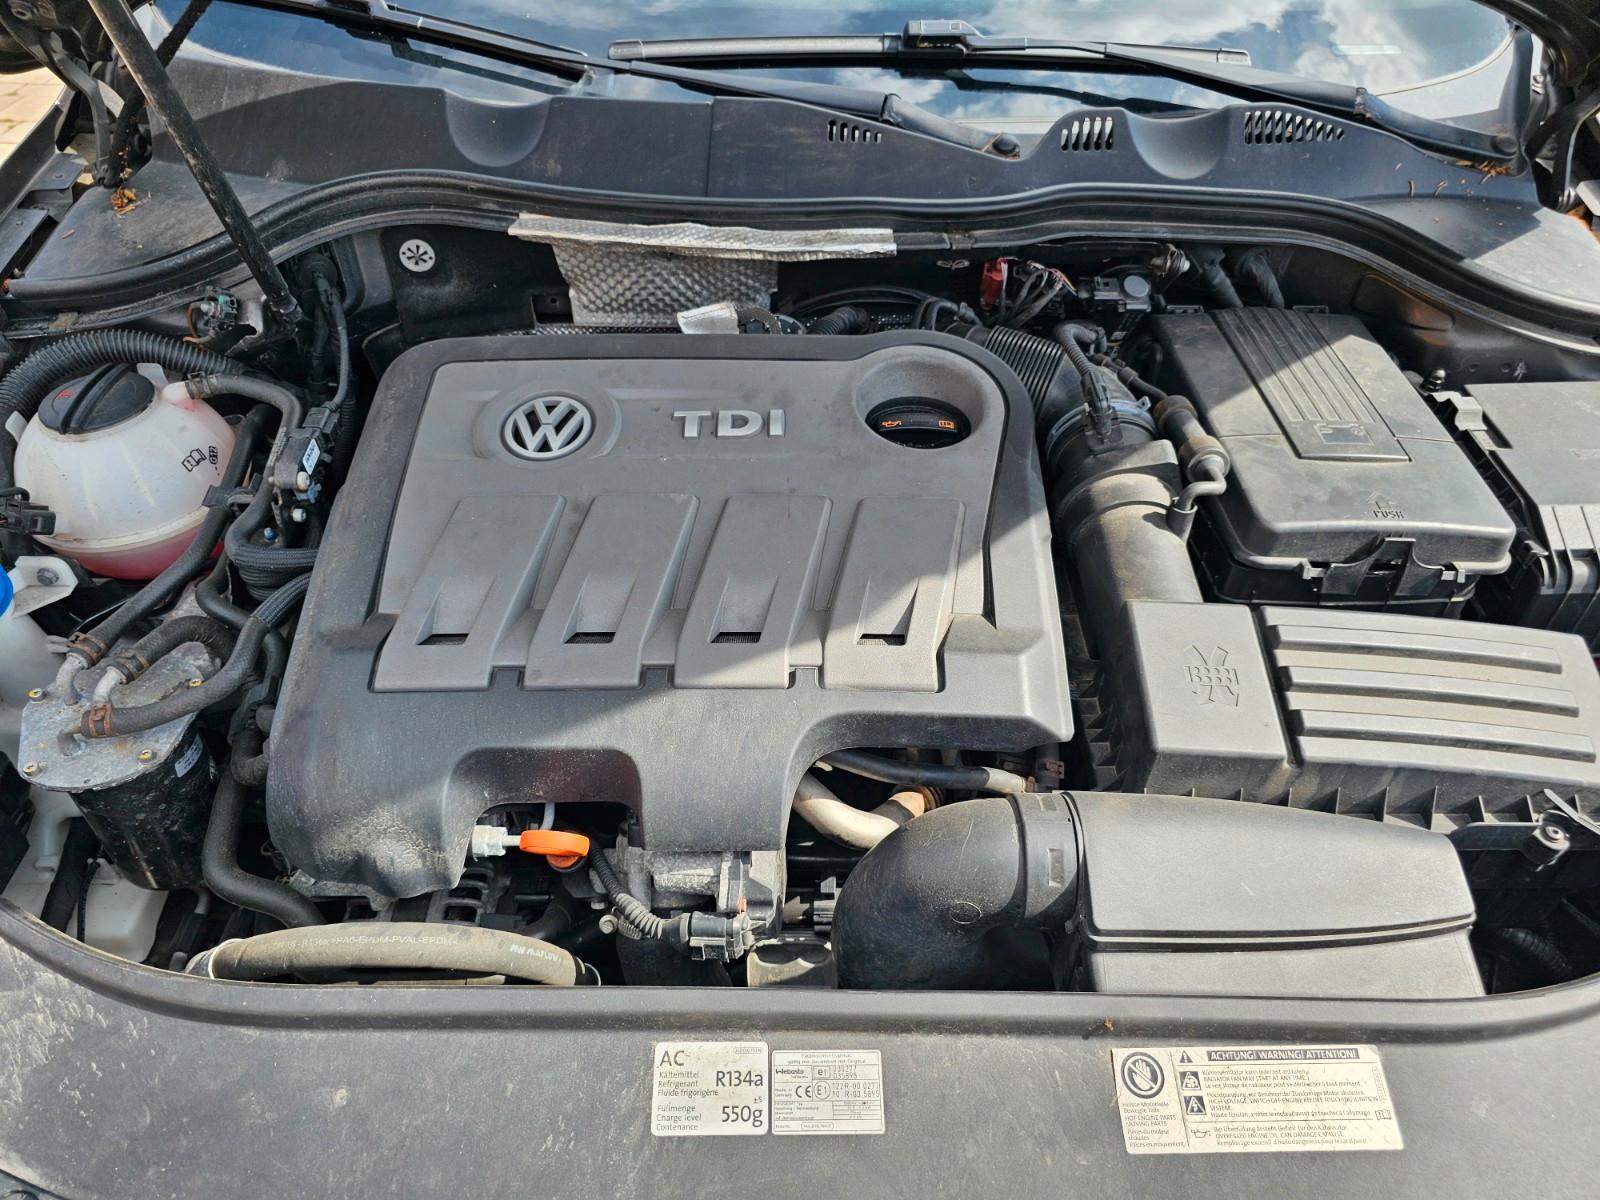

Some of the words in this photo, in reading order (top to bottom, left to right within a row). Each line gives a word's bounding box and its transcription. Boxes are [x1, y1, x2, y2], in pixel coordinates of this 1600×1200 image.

[672, 408, 785, 438] TDI
[659, 1050, 684, 1066] AC
[1210, 1051, 1256, 1060] ACHTUNG!
[1258, 1050, 1304, 1060] WARNING!
[1306, 1049, 1357, 1059] ATTENTION!
[716, 1070, 763, 1087] R134a
[658, 1080, 698, 1089] Refrigerant
[681, 1089, 718, 1098] frigorigène
[657, 1104, 696, 1113] Füllmenge
[657, 1114, 682, 1123] Charge
[684, 1113, 701, 1122] level
[721, 1105, 763, 1127] 550g
